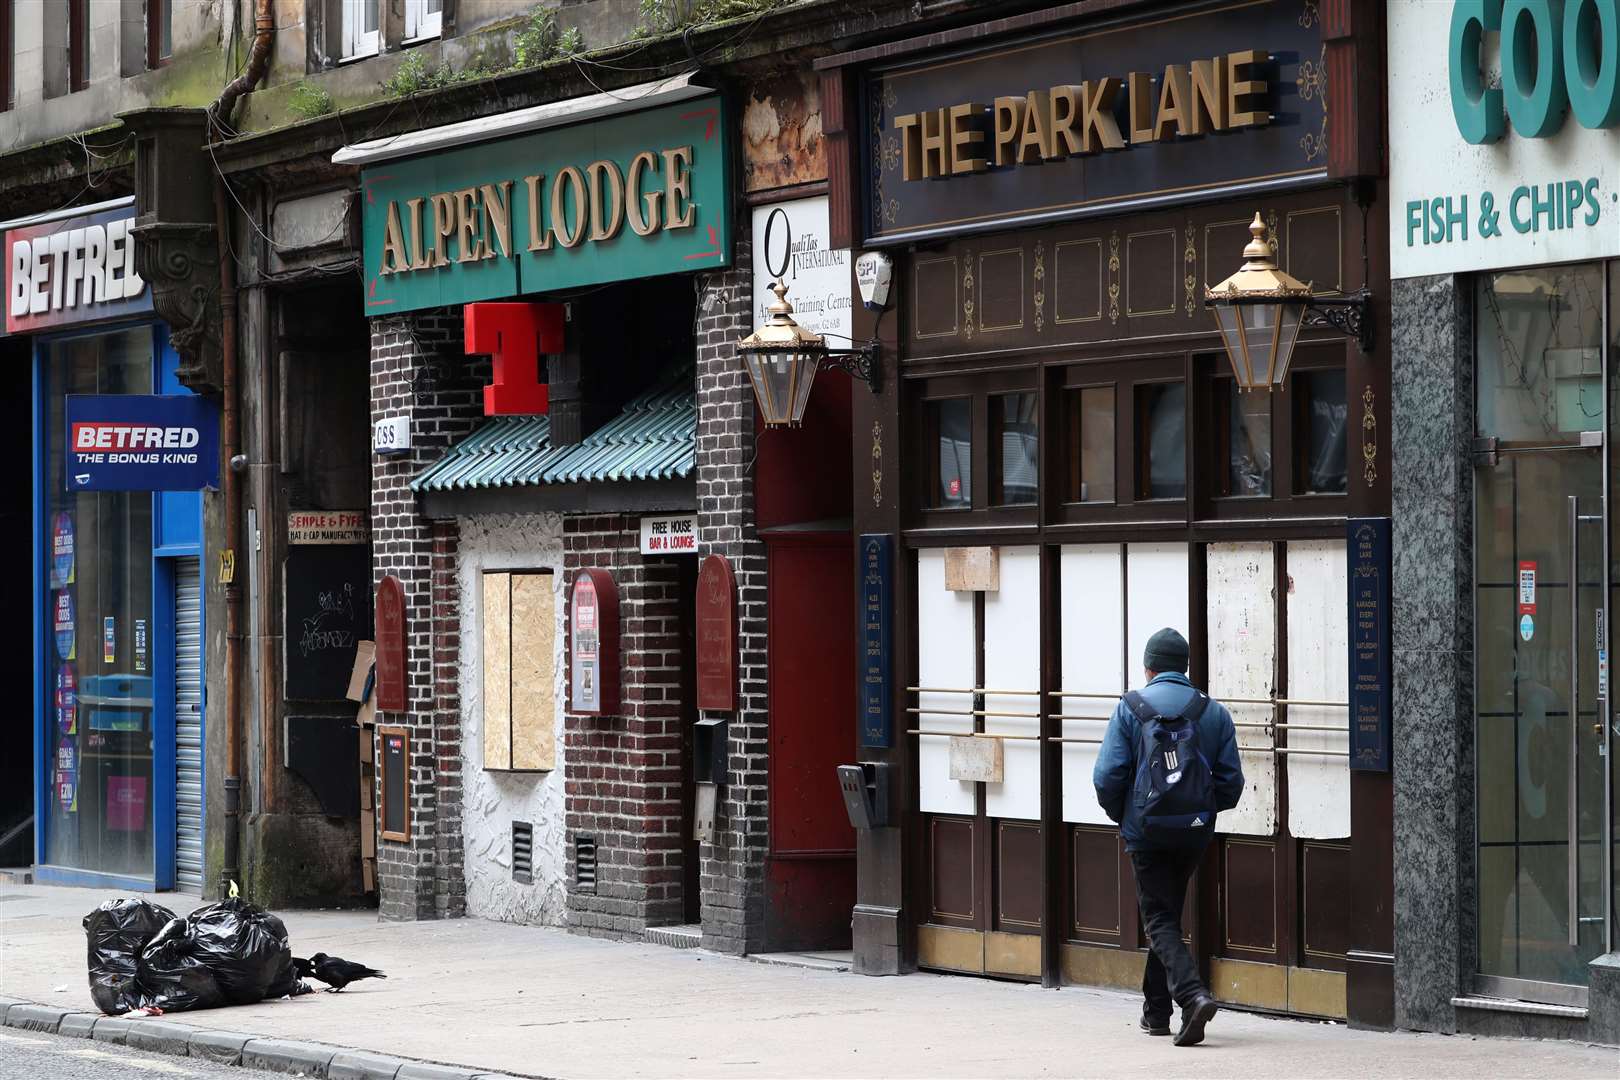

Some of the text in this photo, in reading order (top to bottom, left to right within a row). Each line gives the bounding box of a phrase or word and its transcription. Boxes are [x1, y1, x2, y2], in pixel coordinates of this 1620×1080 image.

[894, 50, 1269, 181] THE PARK LANE
[380, 145, 695, 275] ALPEN LODGE
[1406, 177, 1601, 247] FISH & CHIPS
[858, 260, 876, 277] SPI
[794, 295, 825, 317] Training
[827, 291, 852, 310] Centre
[463, 301, 566, 416] T
[77, 427, 200, 448] BETFRED
[377, 425, 395, 445] CSS
[77, 453, 198, 464] THE BONUS KING
[289, 514, 326, 529] SEMPLE
[652, 519, 692, 534] FREE HOUSE
[290, 531, 301, 541] HAT
[309, 531, 320, 540] CAP
[649, 536, 694, 550] BAR & LOUNGE
